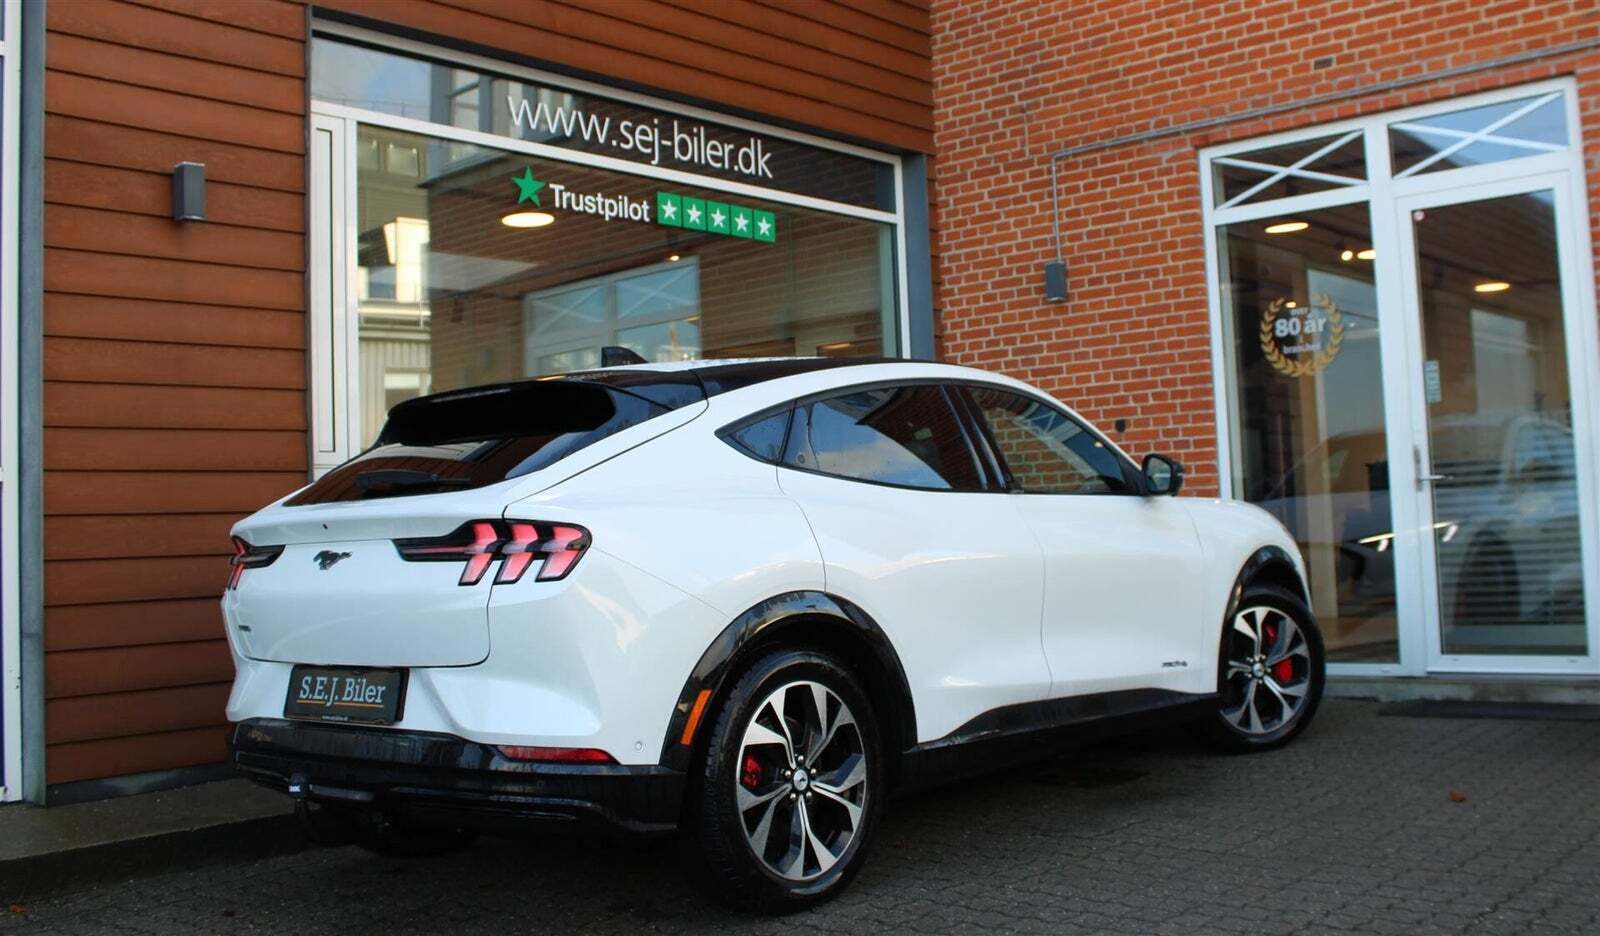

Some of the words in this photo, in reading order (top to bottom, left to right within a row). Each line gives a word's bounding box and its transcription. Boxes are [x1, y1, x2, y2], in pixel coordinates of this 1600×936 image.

[508, 95, 773, 178] www.sej-biler.dk
[549, 183, 650, 222] Trustpilot
[1275, 318, 1301, 337] 80
[299, 676, 339, 707] S.E.J.
[342, 678, 386, 703] Biler
